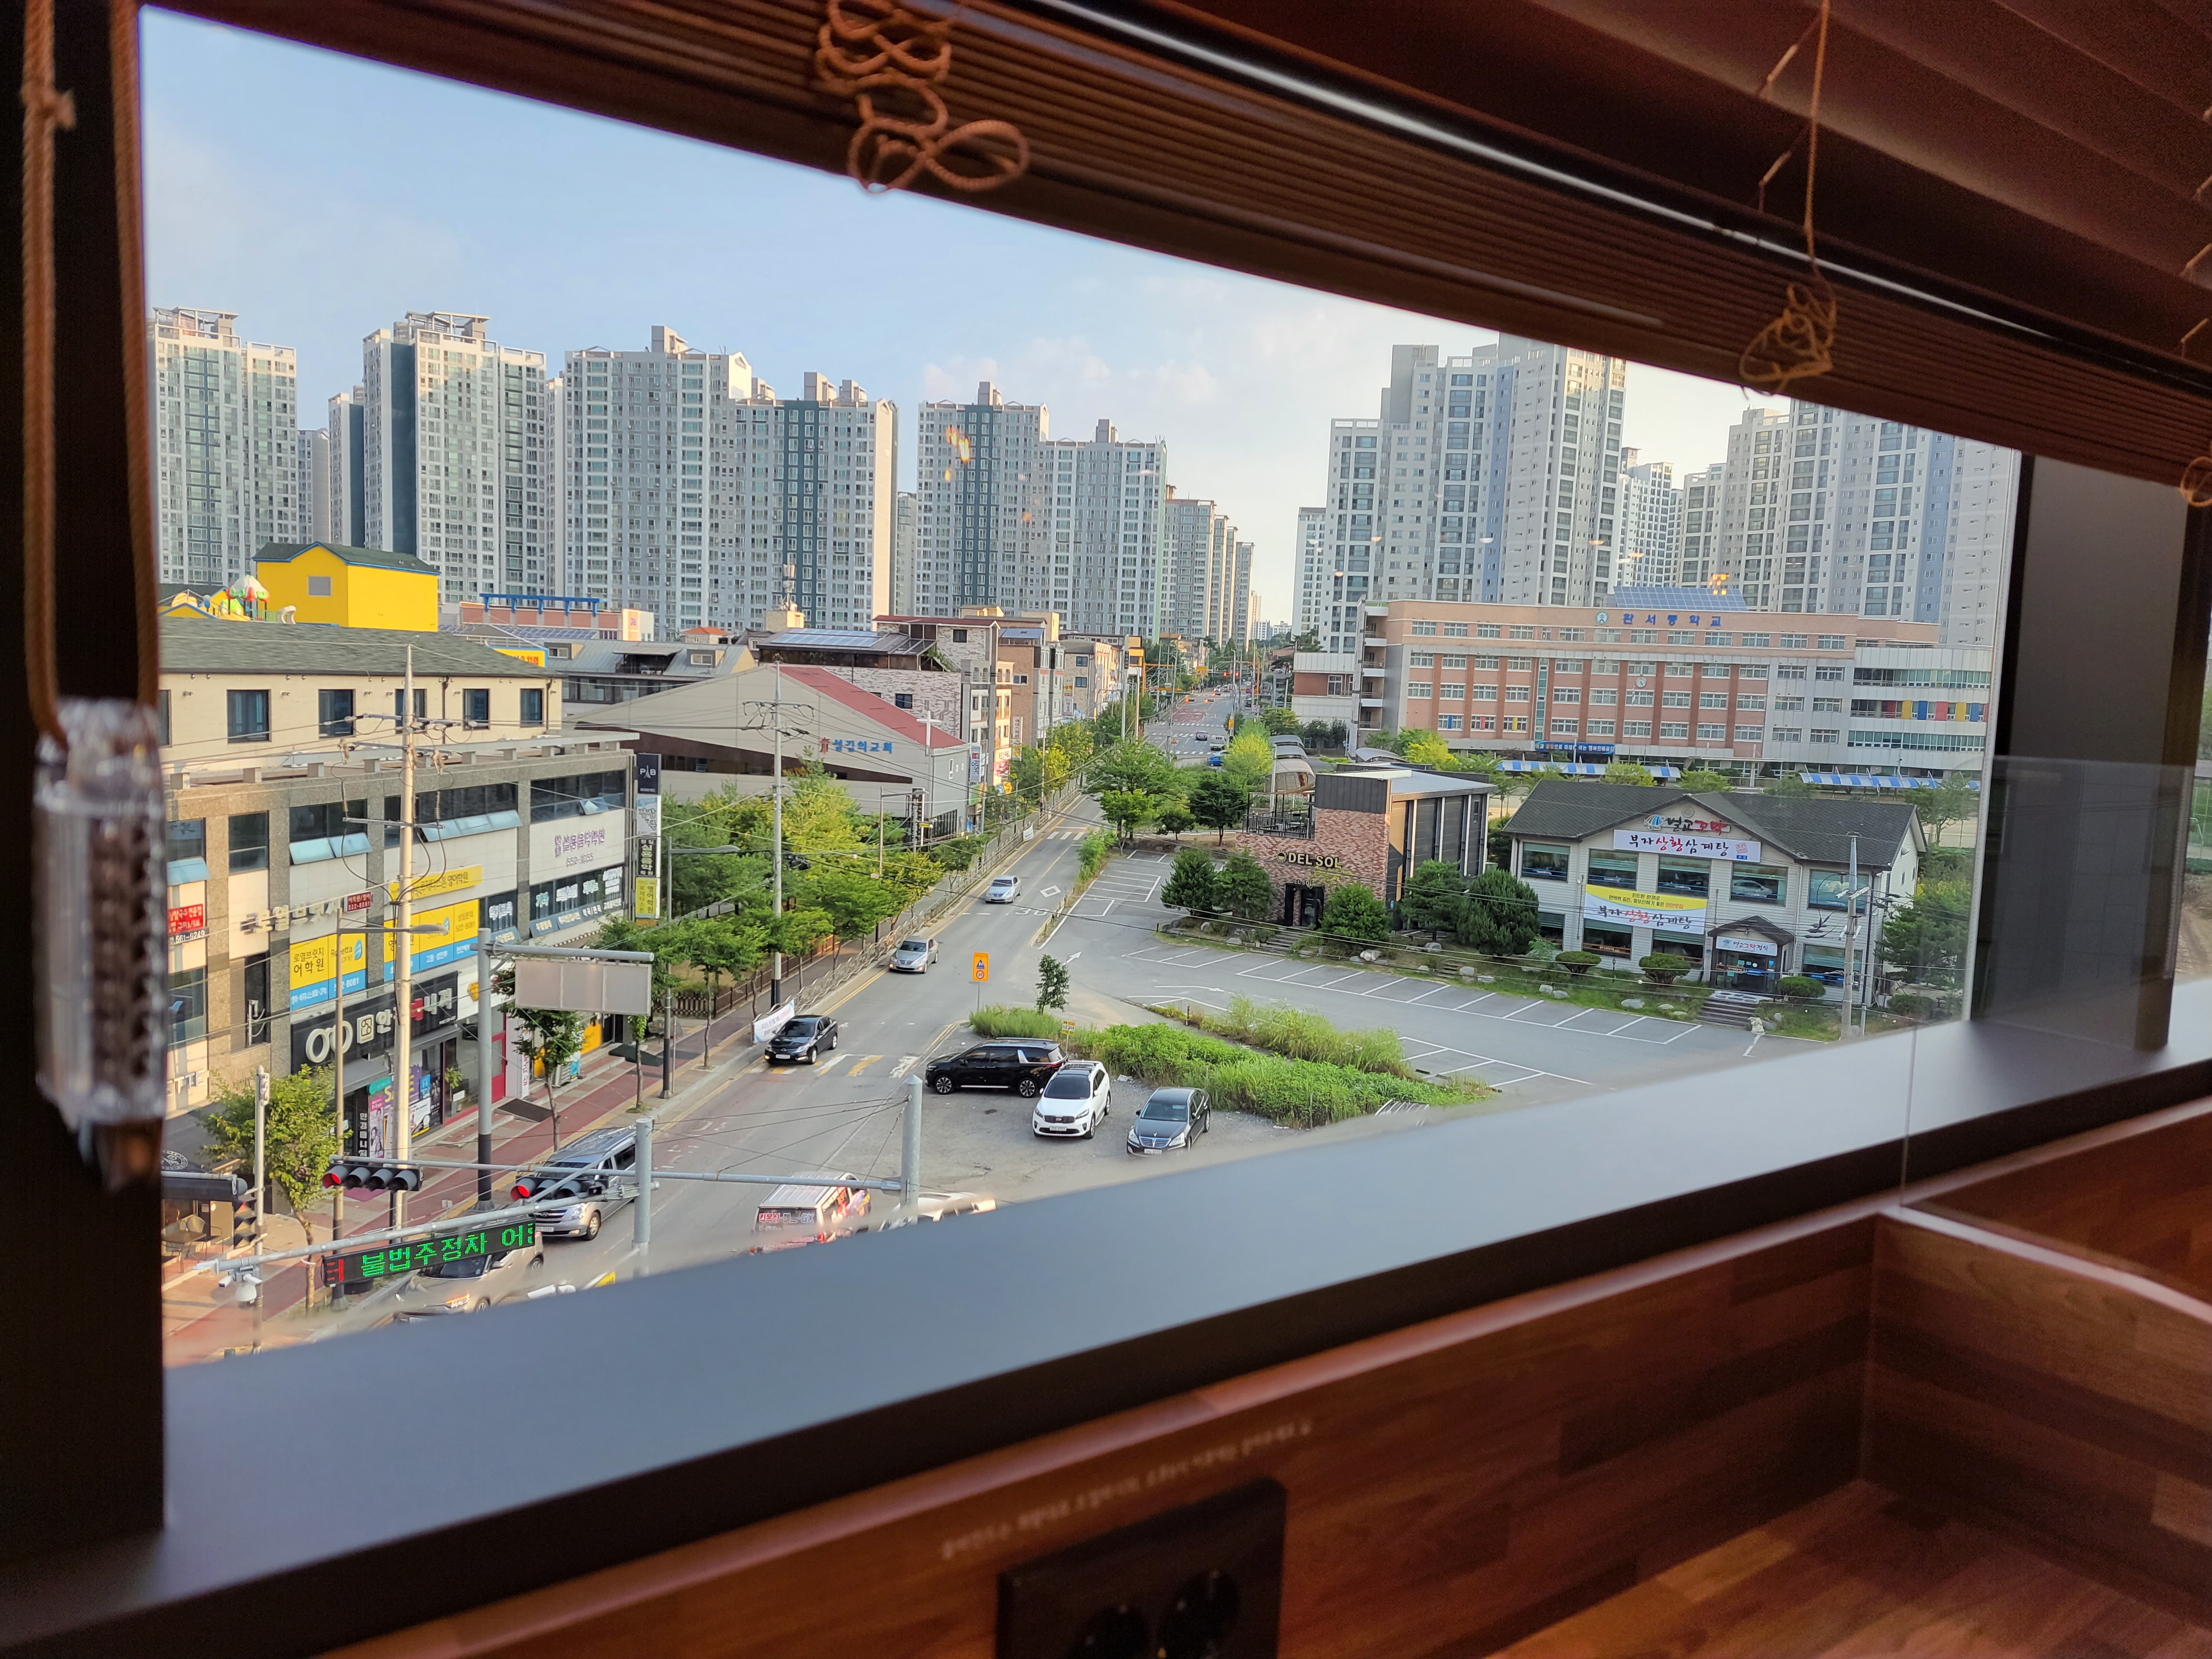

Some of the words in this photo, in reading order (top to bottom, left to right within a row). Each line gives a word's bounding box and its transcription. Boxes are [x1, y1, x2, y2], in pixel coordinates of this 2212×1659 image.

[1288, 852, 1313, 865] DEL
[1315, 855, 1342, 868] SOL
[294, 947, 324, 962] 로열브릿지
[293, 958, 324, 977] 어학원
